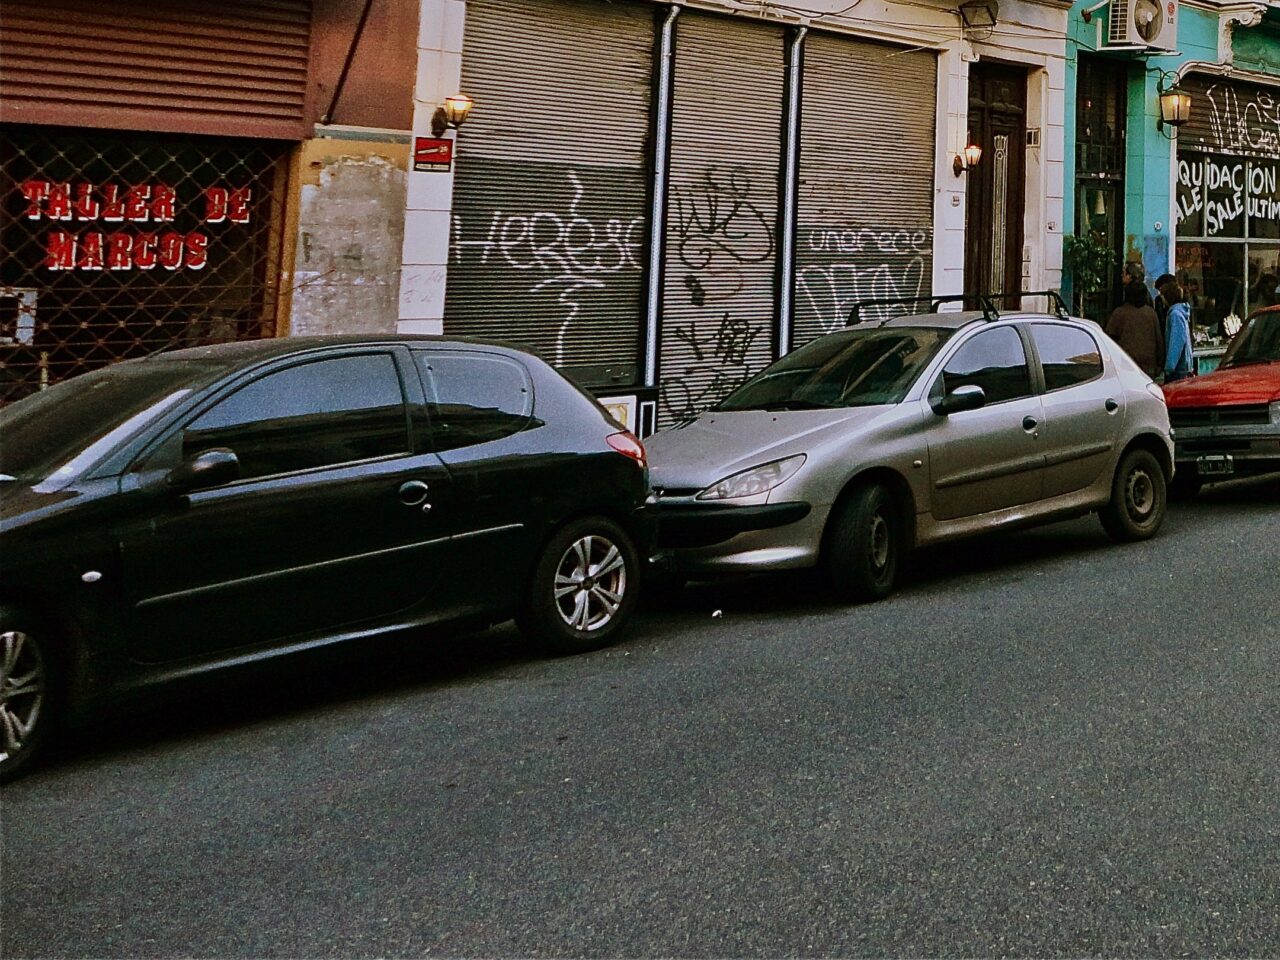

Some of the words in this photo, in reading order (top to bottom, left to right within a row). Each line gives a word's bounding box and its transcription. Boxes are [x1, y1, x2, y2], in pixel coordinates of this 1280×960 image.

[23, 181, 176, 221] TALLER
[207, 187, 251, 223] DE
[1175, 186, 1203, 224] ALE
[1207, 191, 1244, 235] SALE
[47, 232, 208, 270] MARCOS
